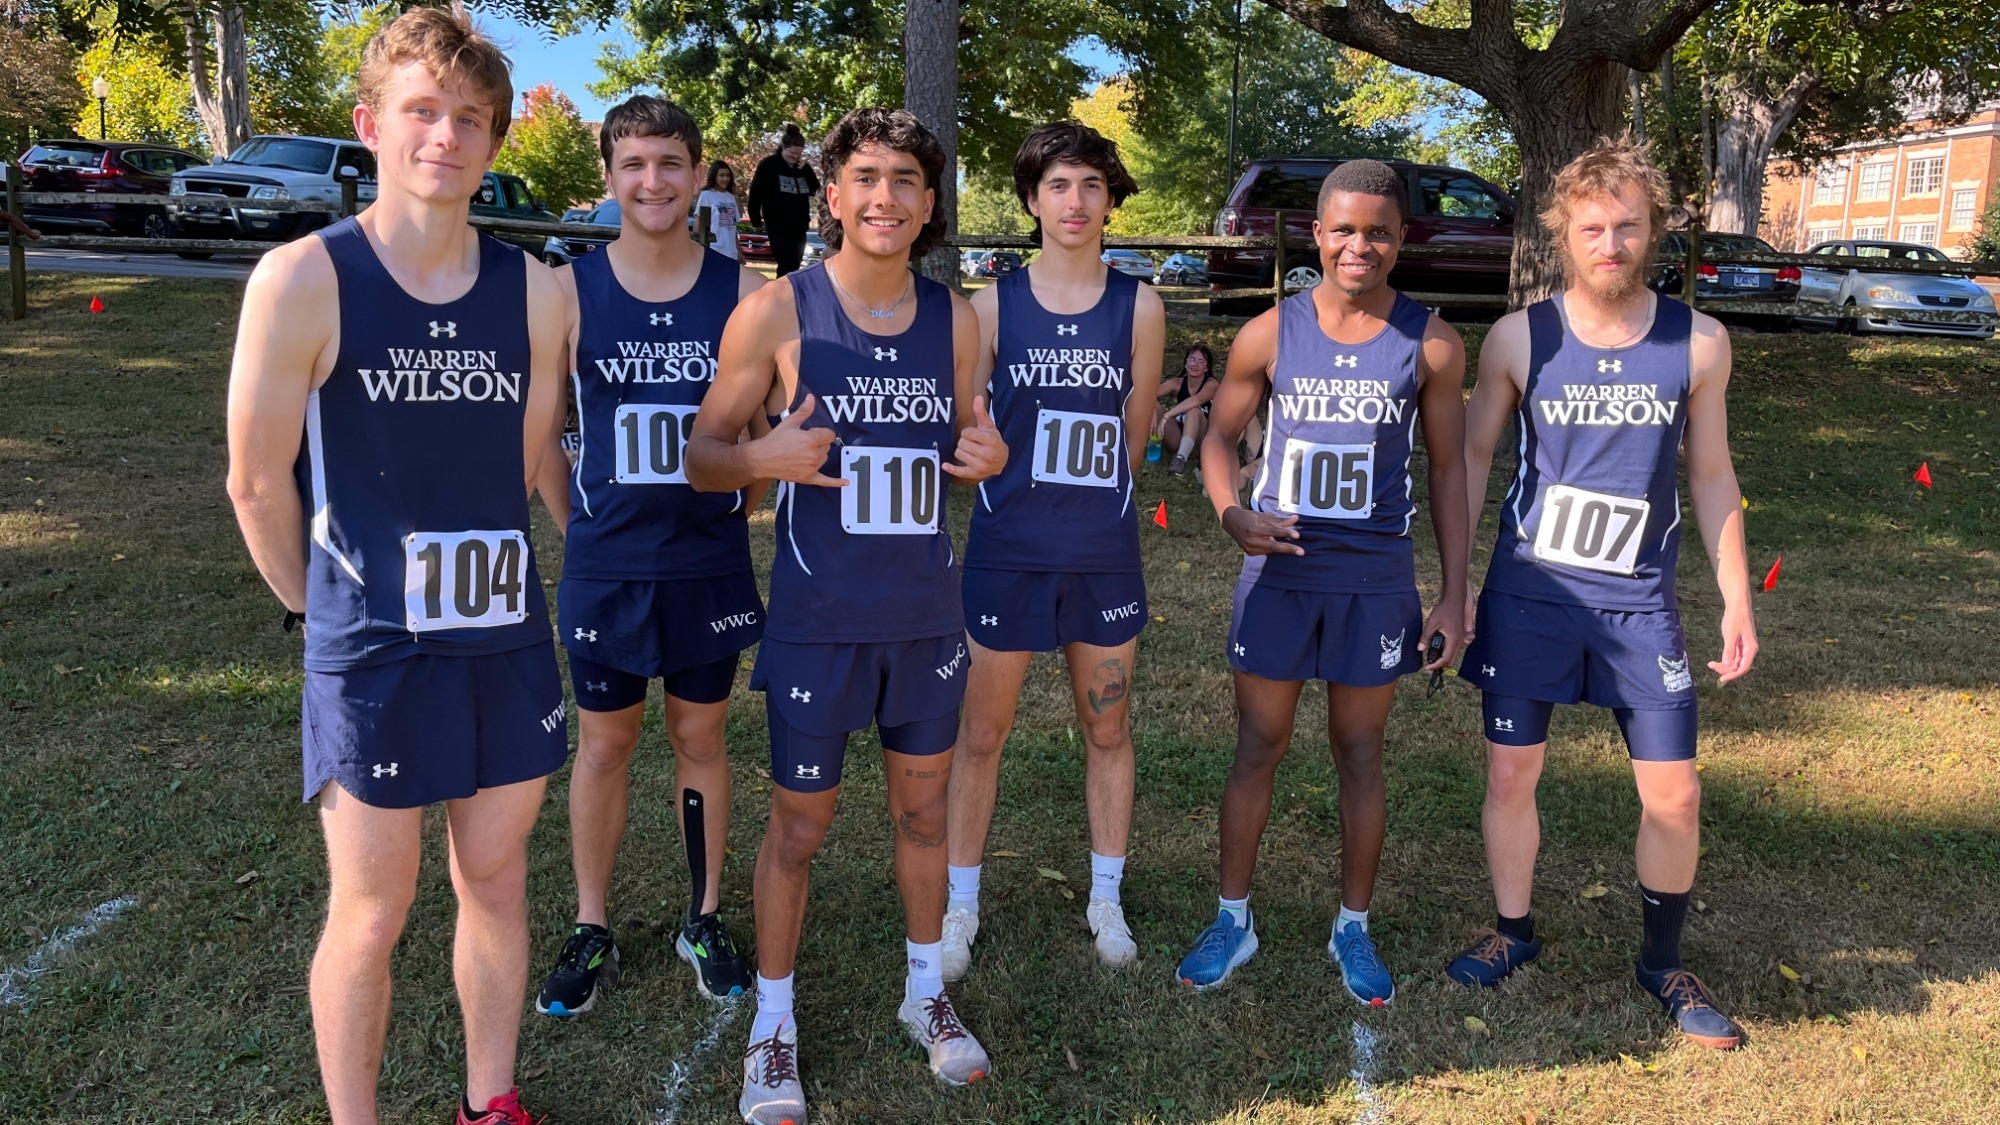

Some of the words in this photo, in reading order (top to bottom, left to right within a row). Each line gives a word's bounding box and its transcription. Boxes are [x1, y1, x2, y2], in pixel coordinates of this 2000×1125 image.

[387, 348, 496, 370] WARREN
[617, 341, 710, 359] WARREN
[1027, 348, 1110, 364] WARREN
[358, 369, 521, 403] WILSON
[846, 376, 936, 396] WARREN
[1008, 363, 1125, 391] WILSON
[1293, 378, 1389, 397] WARREN
[1563, 384, 1658, 400] WARREN
[822, 395, 952, 423] WILSON
[1278, 394, 1407, 424] WILSON
[1540, 400, 1678, 426] WILSON
[1043, 418, 1117, 479] 103
[850, 456, 936, 525] 110
[1289, 449, 1369, 511] 105
[1549, 495, 1645, 562] 107
[417, 539, 522, 619] 104
[710, 612, 757, 634] WWC
[1101, 602, 1139, 622] WWC
[935, 643, 966, 680] WWC
[540, 697, 566, 733] WW
